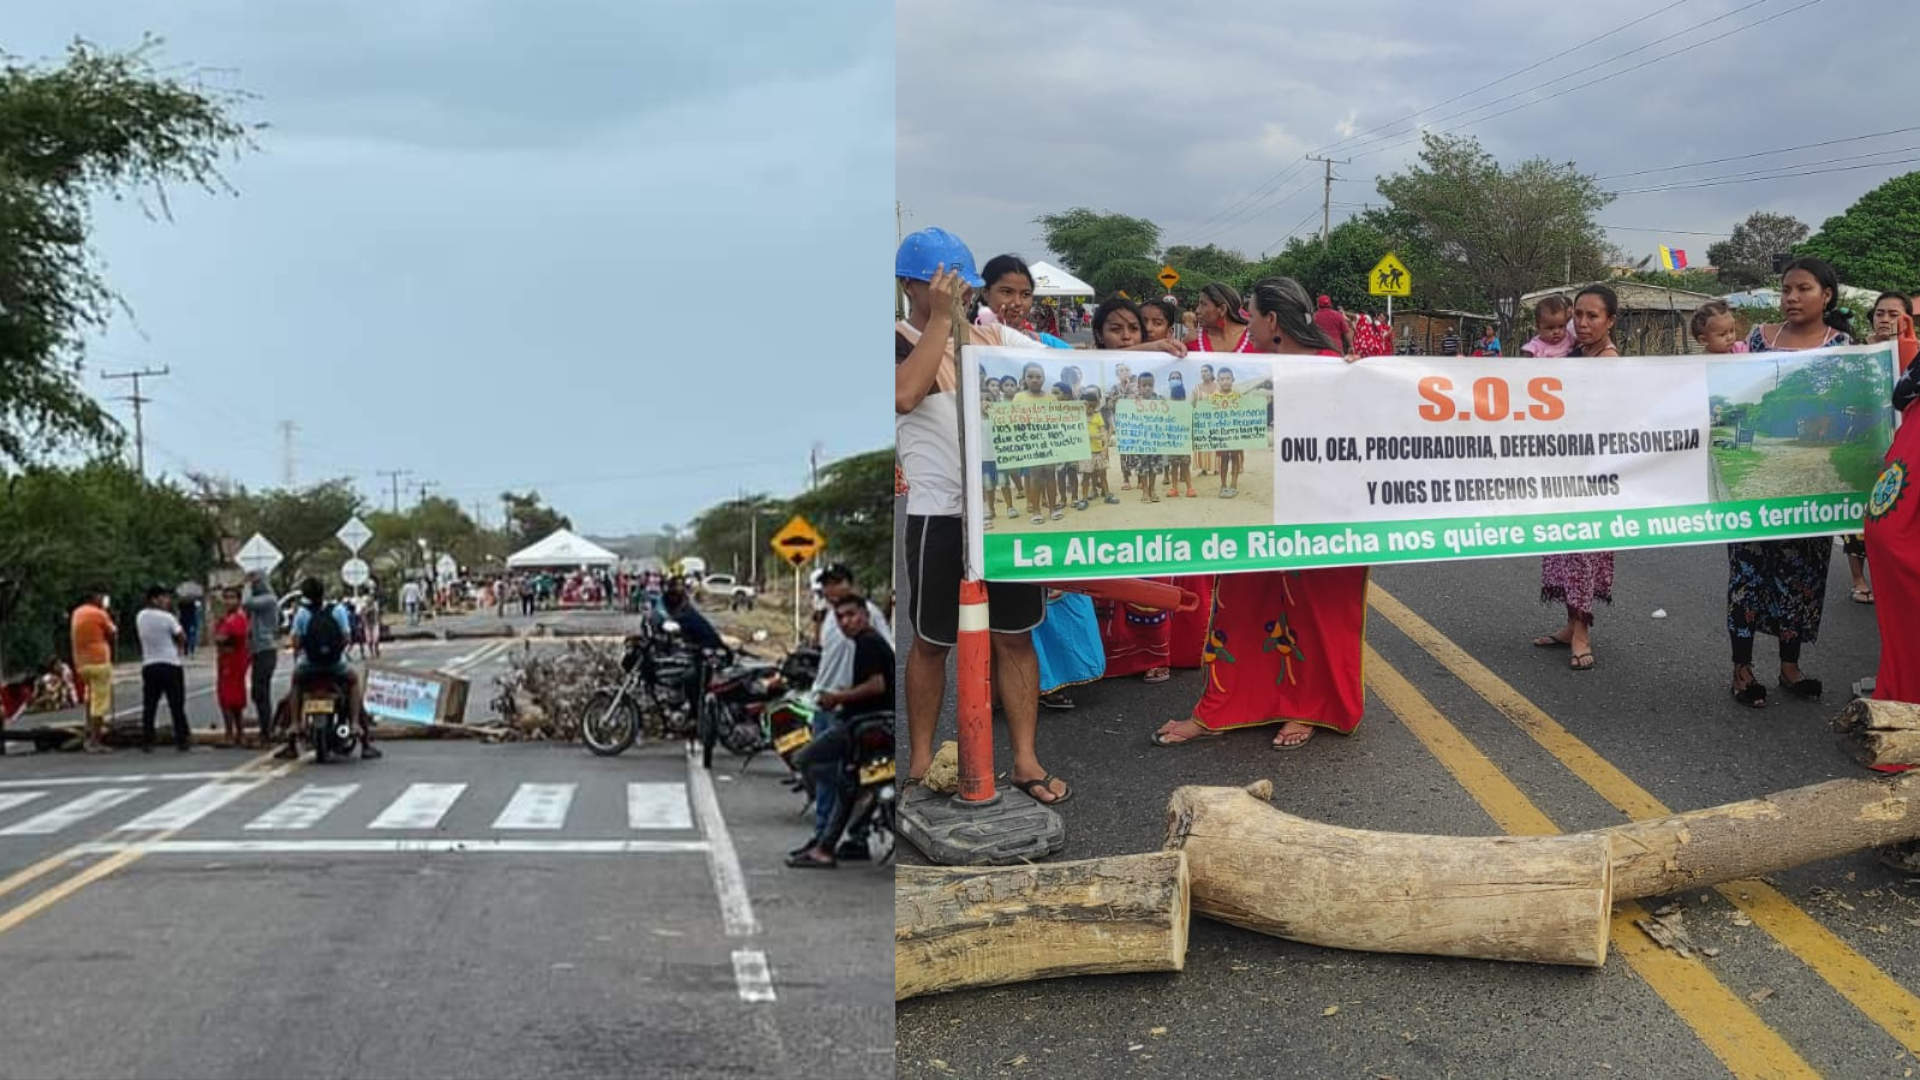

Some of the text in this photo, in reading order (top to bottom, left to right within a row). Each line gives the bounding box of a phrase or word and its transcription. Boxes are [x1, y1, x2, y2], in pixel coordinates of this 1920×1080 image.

[1417, 375, 1565, 423] S.O.S
[1281, 428, 1700, 464] ONU, OEA, PROCURADURIA, DEFENSORIA PERSONERIA
[1366, 473, 1620, 506] Y ONGS DE DERECHOS HUMANOS
[1013, 538, 1053, 568] La
[1063, 532, 1192, 566] Alcaldía
[1202, 532, 1238, 560] de
[1248, 528, 1380, 558] Riohacha
[1388, 530, 1436, 552] nos
[1443, 522, 1526, 554] quiere
[1533, 514, 1603, 544] sacar
[1609, 514, 1641, 539] de
[1648, 508, 1753, 537] nuestros
